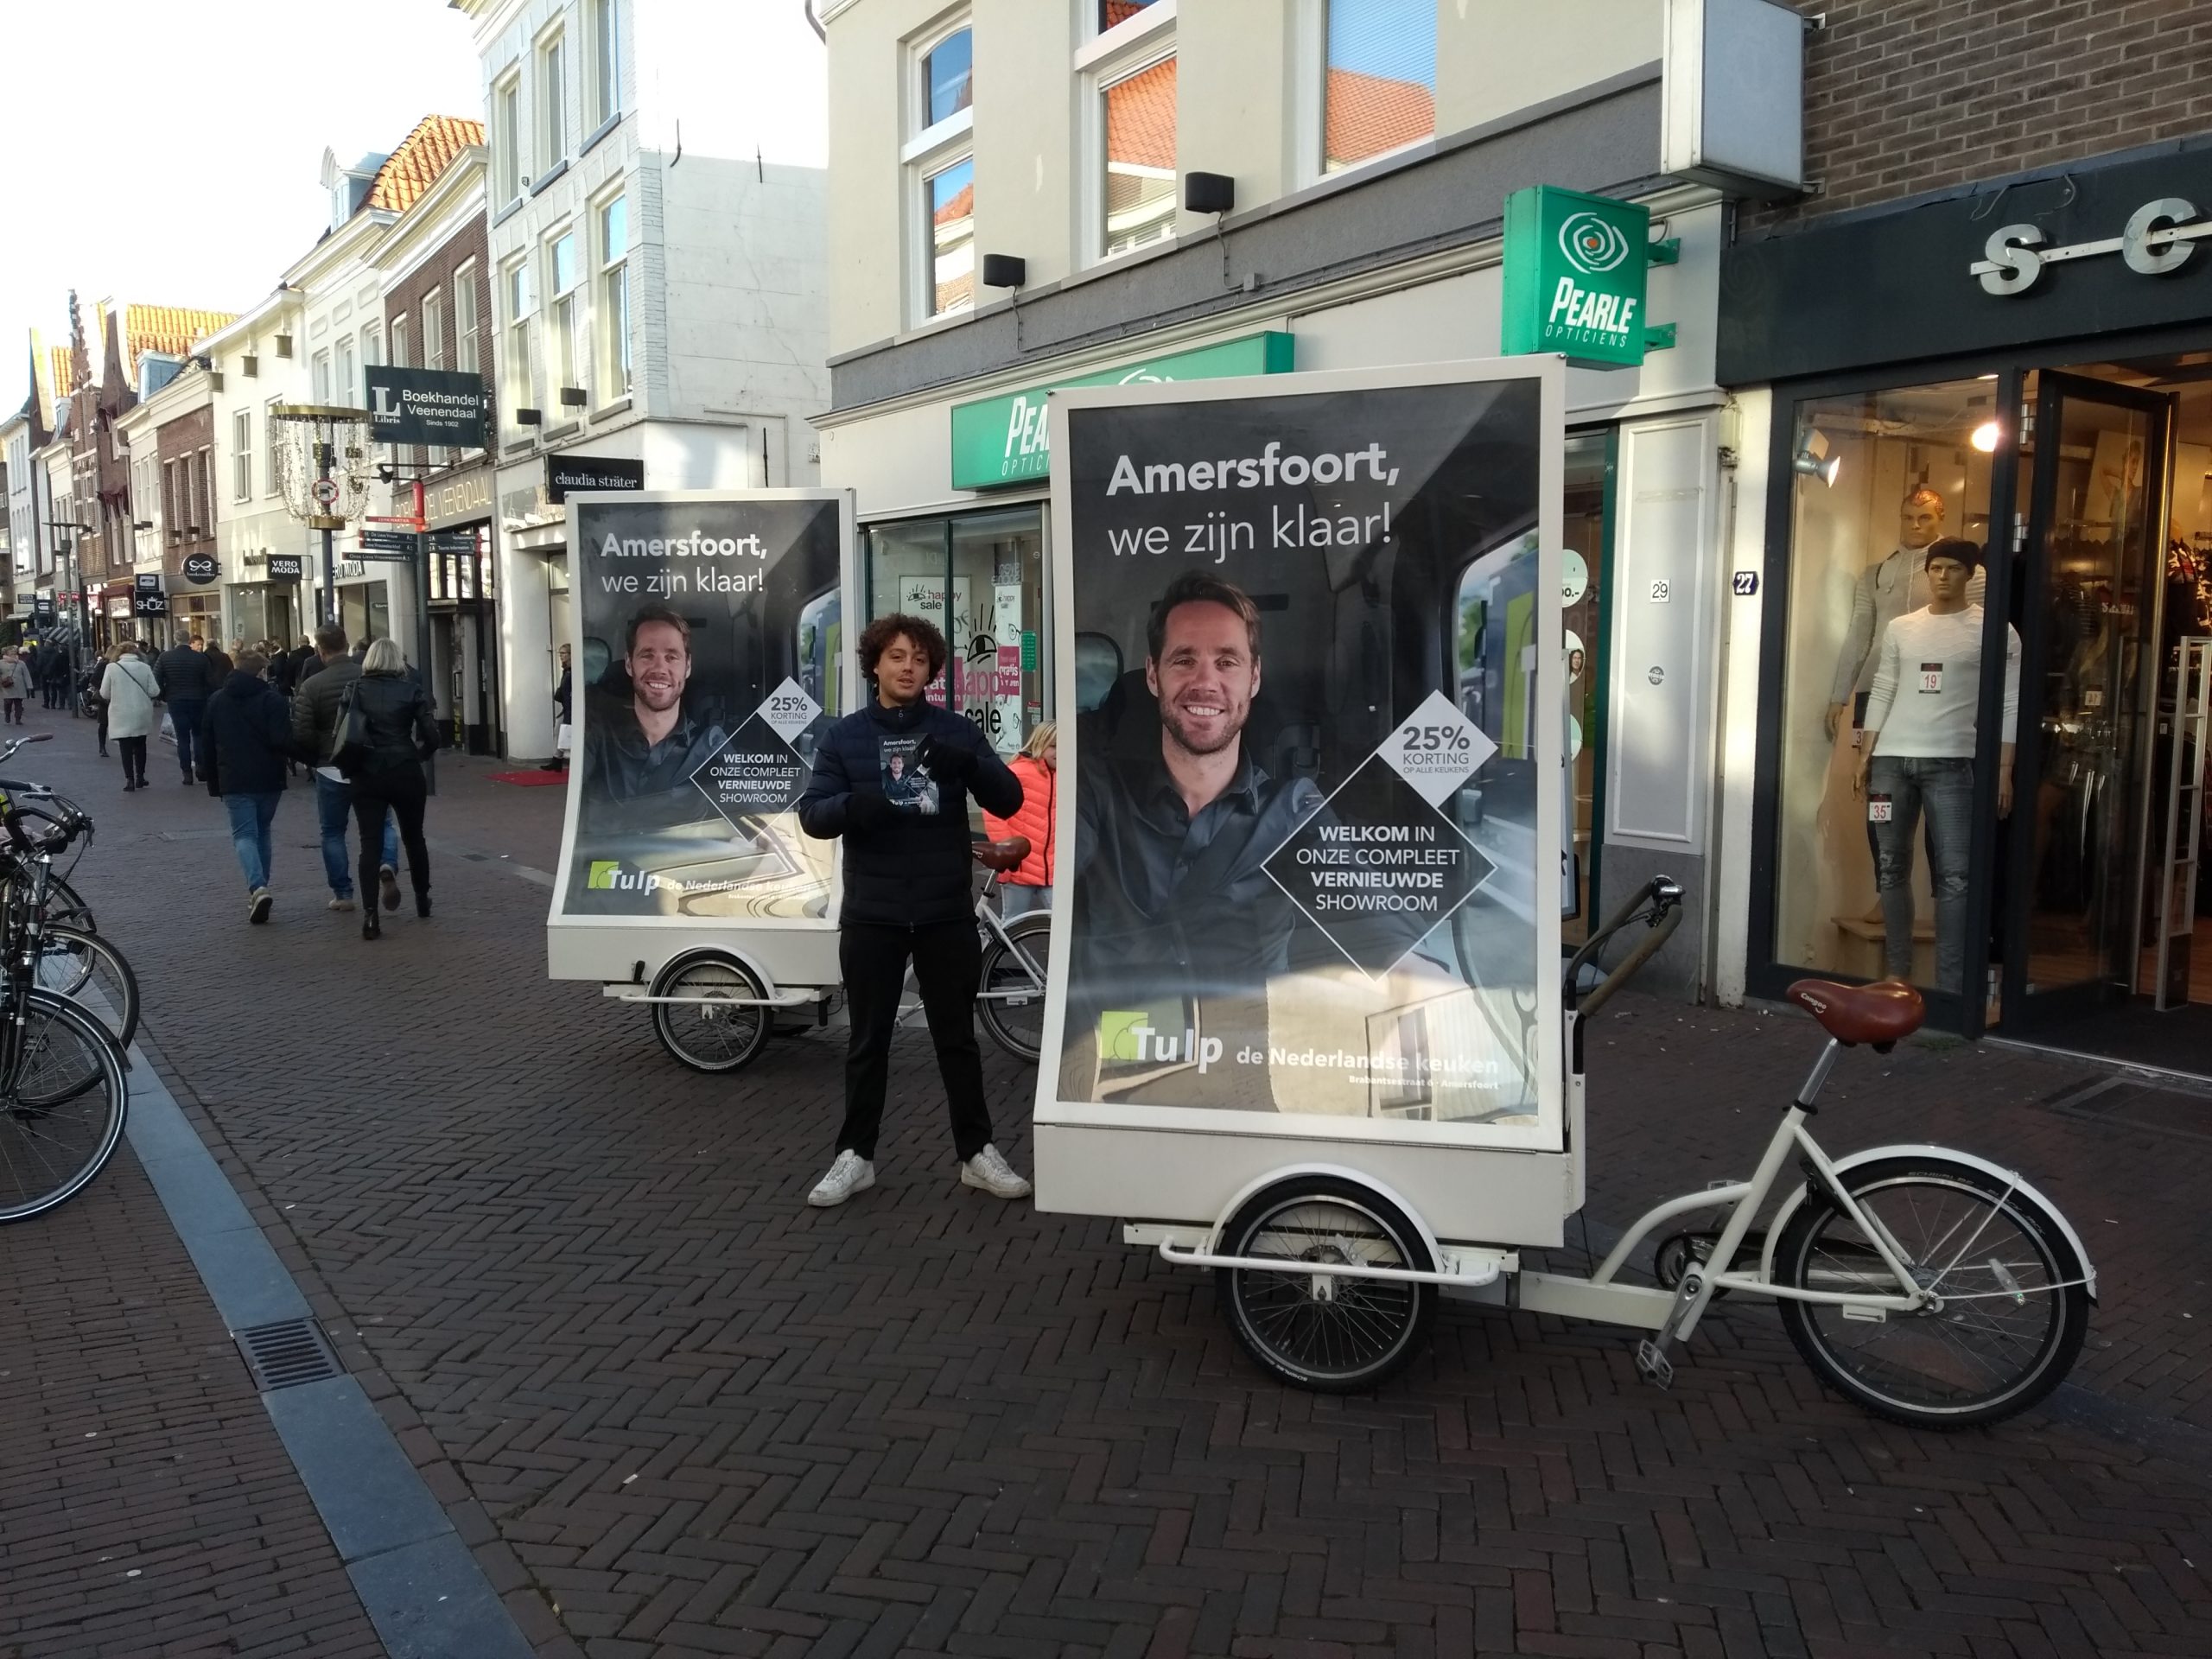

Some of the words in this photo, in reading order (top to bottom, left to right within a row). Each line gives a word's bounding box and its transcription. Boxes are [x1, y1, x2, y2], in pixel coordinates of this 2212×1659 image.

[1549, 276, 1637, 334] PEARLE
[1545, 324, 1627, 348] OPTICIENS
[403, 389, 479, 406] Boekhandel
[407, 404, 476, 418] Veenendaal
[1106, 442, 1400, 496] Amersfoort,
[555, 473, 596, 486] claudia
[598, 476, 637, 488] sträter
[439, 477, 492, 517] VEENENDAAL
[1108, 524, 1169, 556] we
[1184, 511, 1254, 564] zijn
[1273, 501, 1391, 548] klaar!
[600, 531, 767, 560] Amersfoort,
[346, 561, 363, 576] MODA
[601, 575, 639, 593] we
[646, 569, 687, 600] zijn
[696, 566, 764, 592] klaar!
[1652, 583, 1669, 599] 29
[1736, 573, 1753, 594] 27
[920, 601, 942, 610] sale
[1924, 674, 1937, 689] 19
[771, 696, 808, 711] 25%
[1402, 725, 1471, 751] 25%
[723, 753, 773, 764] WELKOM
[777, 754, 788, 764] IN
[1403, 753, 1469, 765] KORTING
[709, 766, 741, 777] ONZE
[743, 767, 801, 777] COMPLEET
[718, 780, 791, 790] VERNIEUWDE
[719, 793, 787, 803] SHOWROOM
[1873, 804, 1886, 819] 35
[1319, 826, 1408, 842] WELKOM
[1414, 826, 1435, 842] IN
[1296, 849, 1350, 865] ONZE
[1355, 849, 1460, 865] COMPLEET
[607, 869, 661, 896] Tulp
[667, 880, 683, 891] de
[1311, 871, 1443, 888] VERNIEUWDE
[1316, 894, 1438, 911] SHOWROOM
[1801, 992, 1827, 1010] Cangoo
[1131, 1027, 1224, 1074] Tulp
[1236, 1046, 1263, 1065] de
[1268, 1047, 1409, 1071] Nederlandse
[1416, 1052, 1499, 1074] keuken
